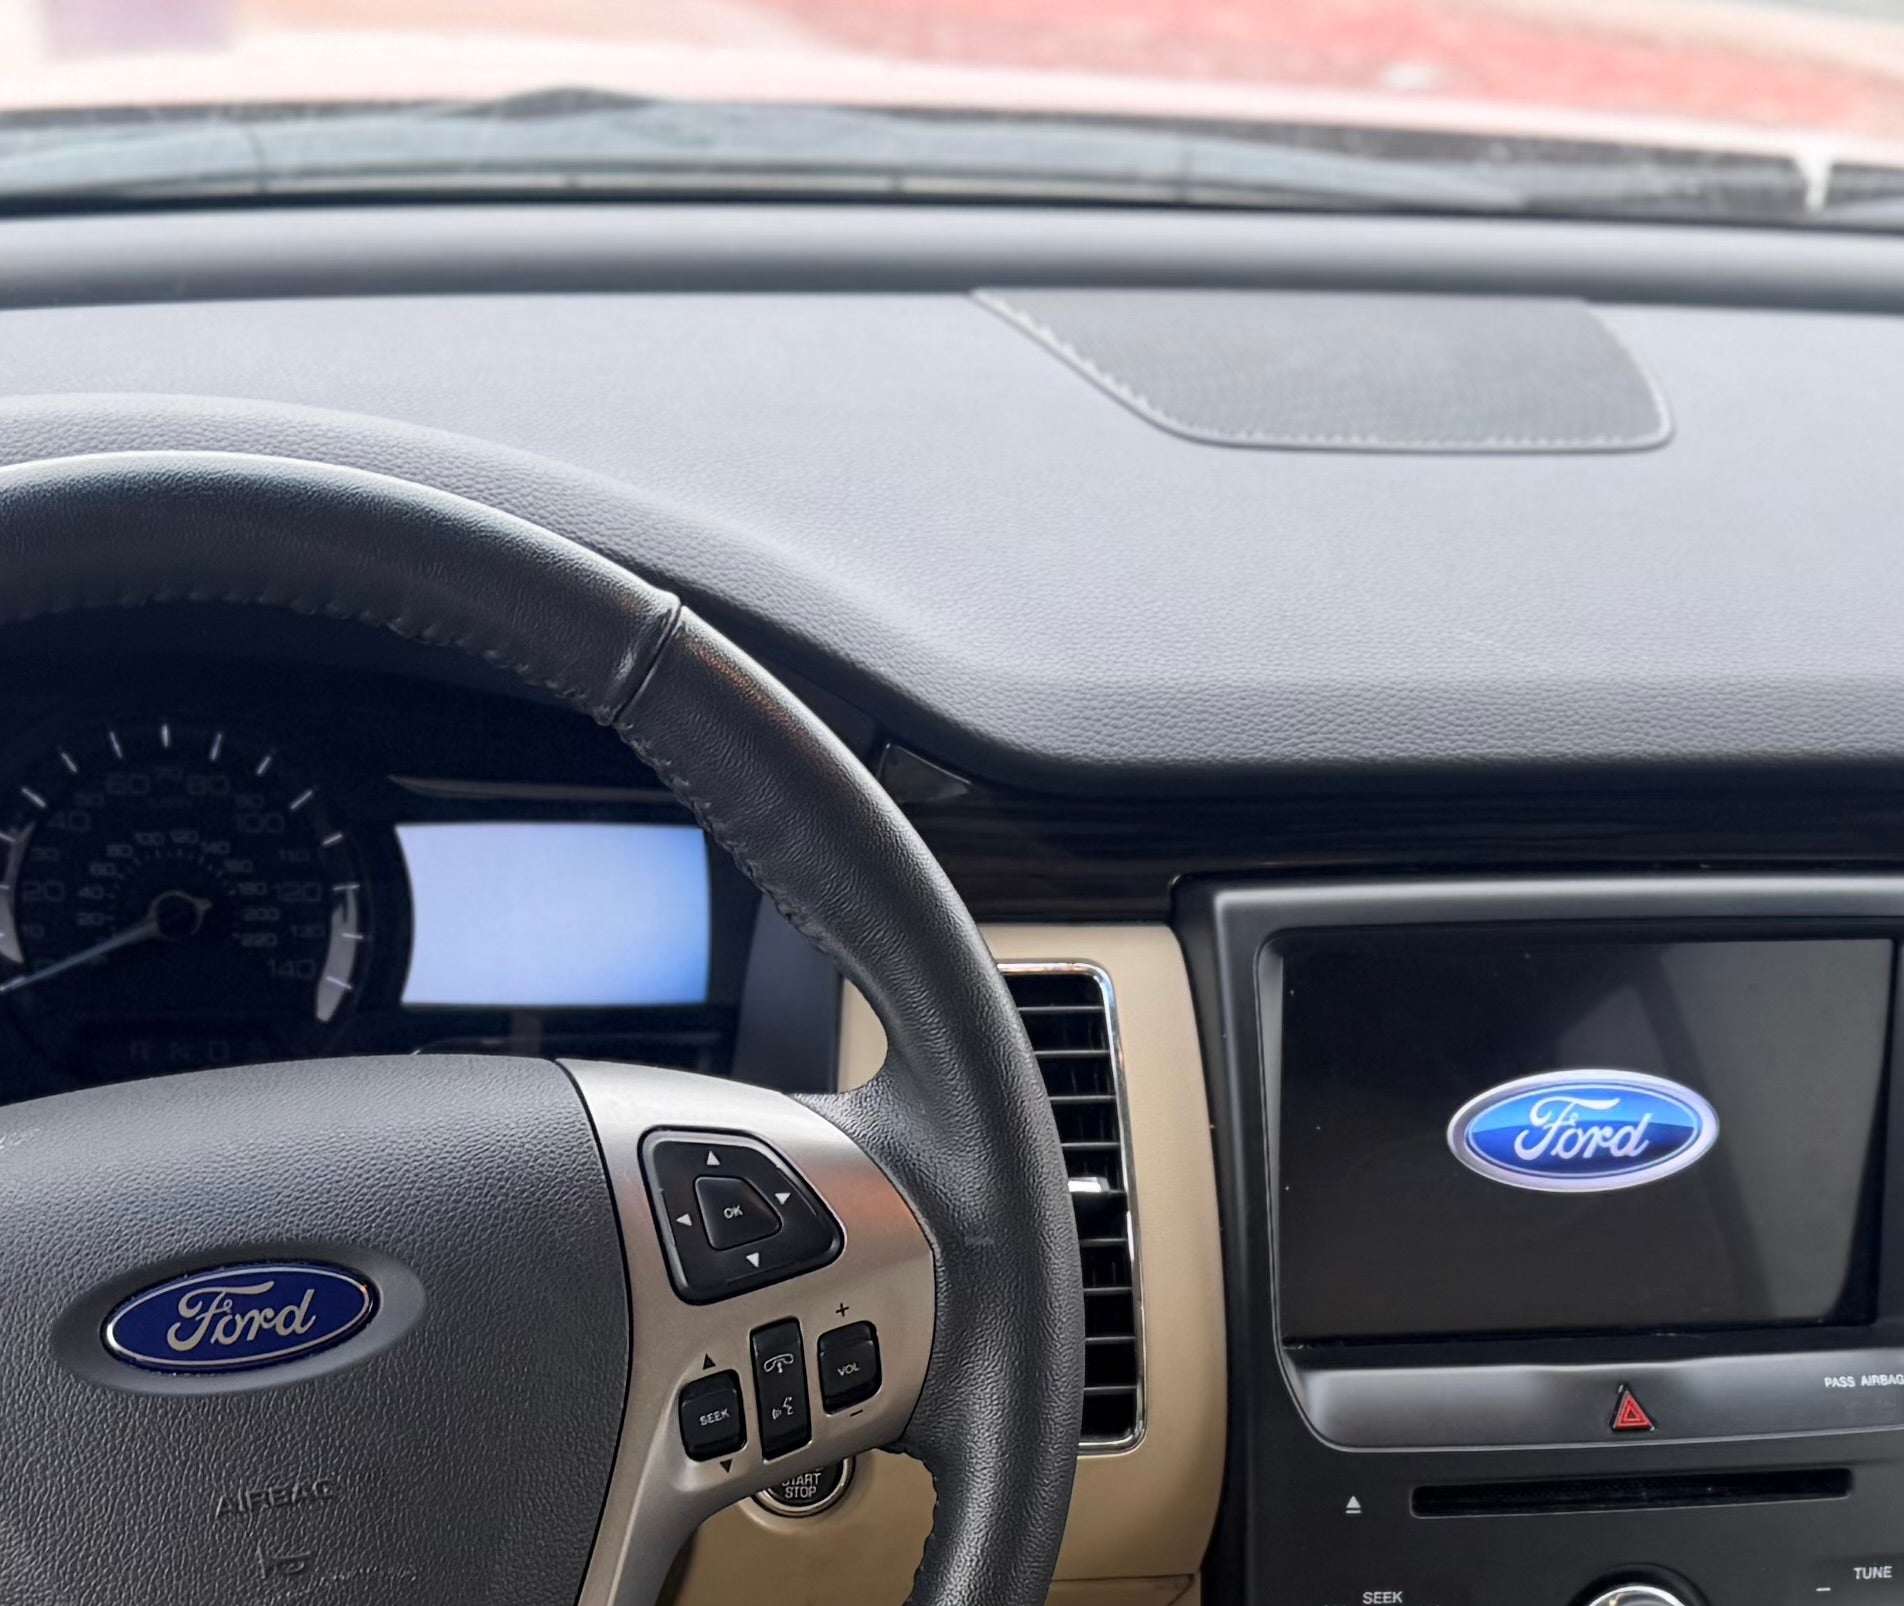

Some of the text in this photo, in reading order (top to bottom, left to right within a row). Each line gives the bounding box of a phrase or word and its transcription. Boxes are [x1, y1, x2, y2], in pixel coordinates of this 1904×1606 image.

[1514, 1097, 1653, 1161] Ford
[723, 1205, 742, 1219] OK
[166, 1280, 316, 1351] Ford
[837, 1361, 860, 1376] VOL
[1824, 1376, 1856, 1388] PASS
[699, 1407, 731, 1427] SEEK
[785, 1486, 817, 1498] STOP
[1853, 1566, 1892, 1581] TUNE
[1362, 1592, 1404, 1605] SEEK
